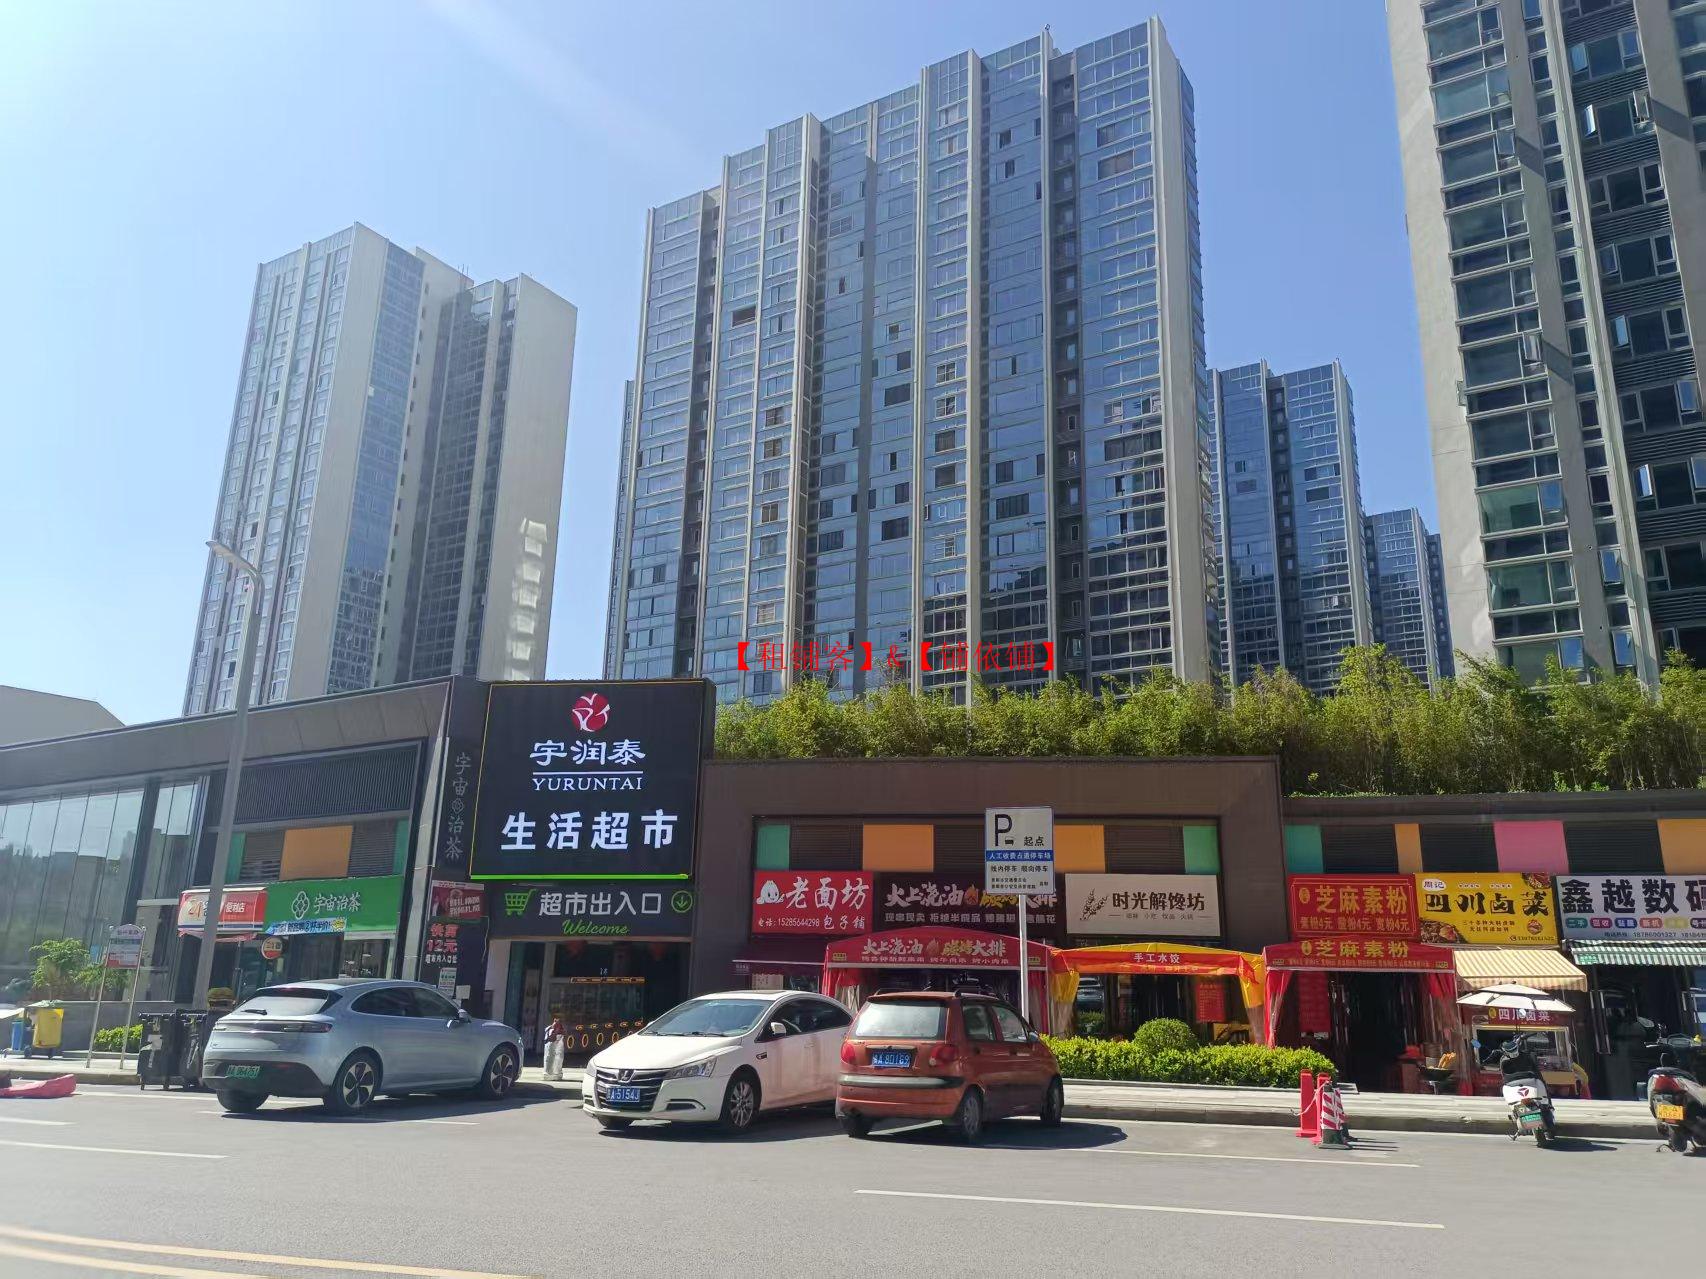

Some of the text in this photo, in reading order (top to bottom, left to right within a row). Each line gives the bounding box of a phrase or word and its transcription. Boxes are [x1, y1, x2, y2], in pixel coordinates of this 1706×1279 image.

[530, 739, 646, 766] 宇润泰
[532, 777, 643, 791] YURUNTAI
[501, 809, 678, 850] 生活超市
[994, 813, 1013, 847] P
[1023, 835, 1045, 847] 起点
[785, 876, 870, 910] 老面坊
[883, 881, 965, 908] 火上浇油
[1423, 880, 1445, 890] 周记
[538, 891, 663, 916] 超市出入口
[1111, 891, 1206, 911] 时光解馋坊
[1314, 885, 1408, 914] 芝麻素粉
[1424, 890, 1550, 917] 四川卤菜
[561, 918, 631, 936] Welcome
[861, 938, 924, 956] 火上浇油
[1314, 940, 1409, 958] 芝麻素粉
[1133, 953, 1181, 964] 手工水饺
